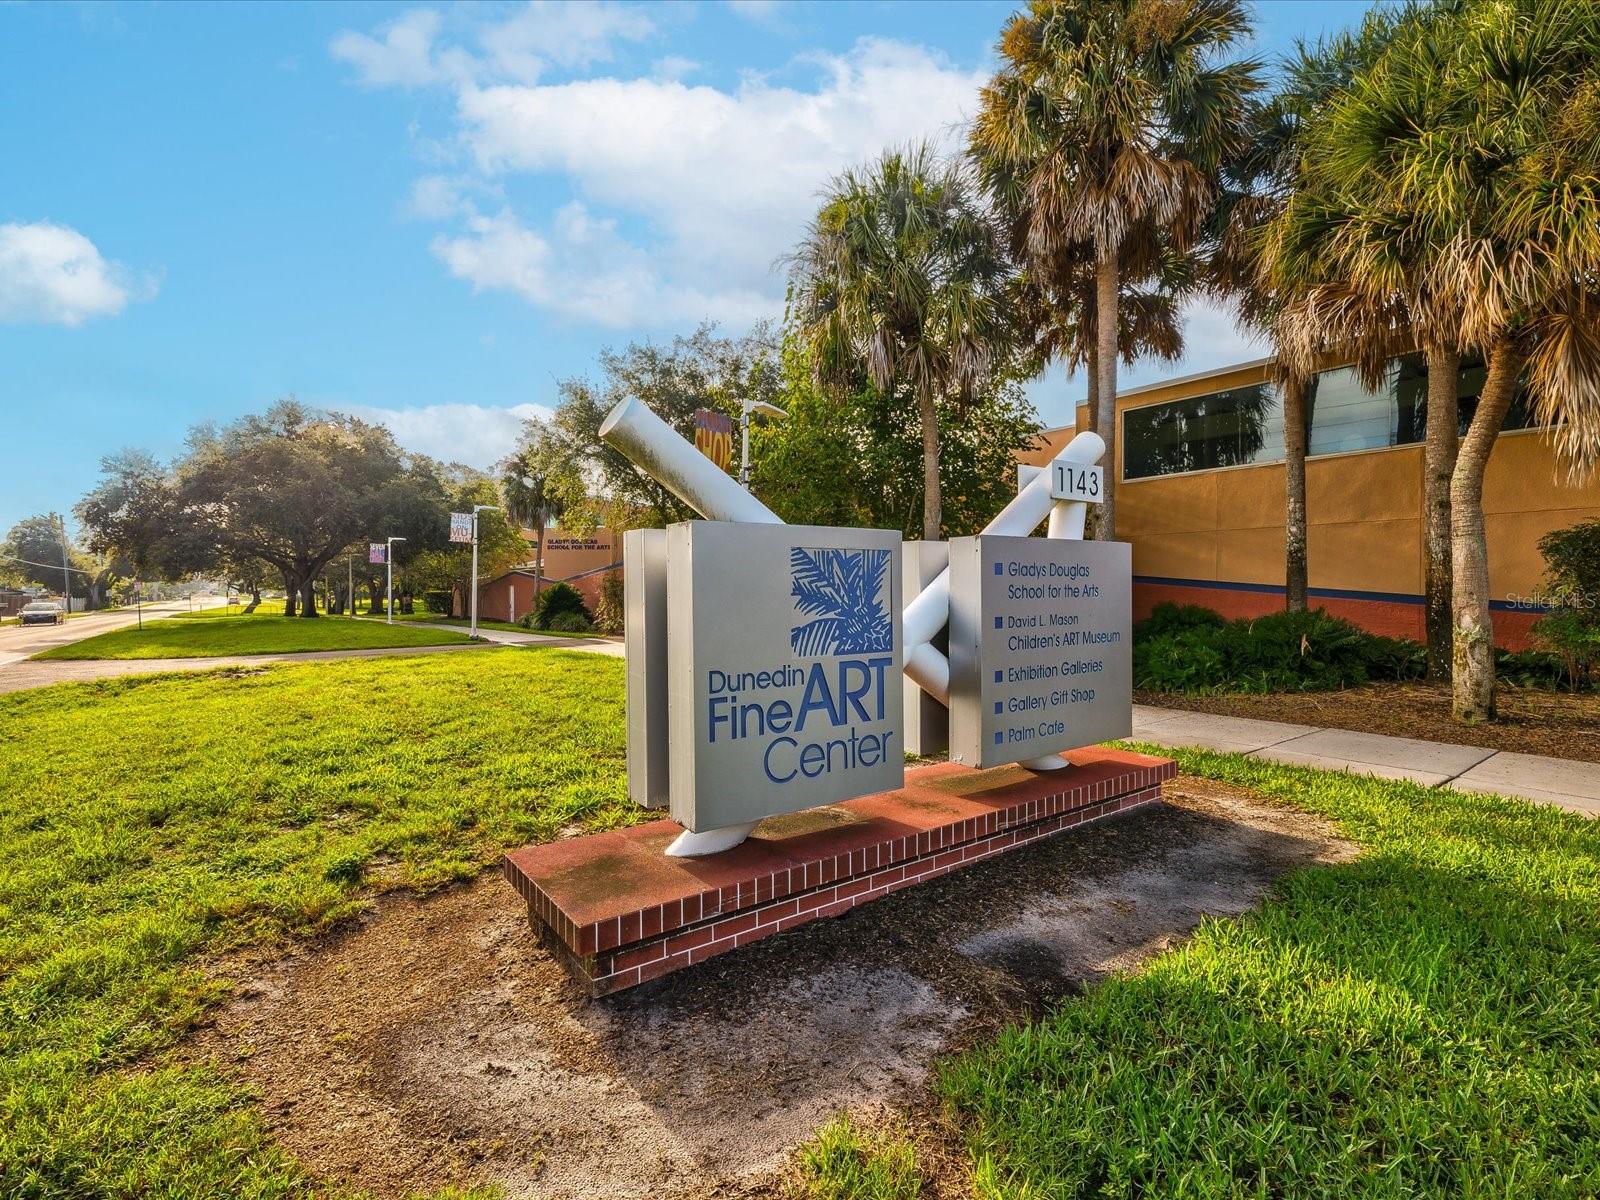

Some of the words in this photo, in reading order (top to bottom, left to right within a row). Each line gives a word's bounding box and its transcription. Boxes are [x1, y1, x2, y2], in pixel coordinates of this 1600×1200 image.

[1058, 467, 1098, 496] 1143
[1008, 562, 1047, 579] Gladys
[1049, 563, 1090, 580] Douglas
[1008, 584, 1045, 599] School
[1048, 585, 1061, 598] for
[1064, 584, 1080, 598] the
[1082, 585, 1099, 597] Arts
[1008, 615, 1036, 629] David
[1039, 615, 1047, 627] L.
[1049, 614, 1079, 626] Mason
[1008, 634, 1060, 651] Children's
[1063, 632, 1080, 647] ART
[1082, 630, 1120, 645] Museum
[708, 664, 805, 694] Dunedin
[1008, 664, 1058, 682] Exhibition
[1061, 660, 1103, 676] Galleries
[708, 696, 794, 743] Fine
[793, 657, 893, 732] ART
[1008, 696, 1048, 713] Gallery
[1050, 691, 1069, 706] Gift
[1071, 688, 1095, 703] Shop
[1008, 727, 1035, 743] Palm
[1038, 720, 1064, 737] Cafe
[763, 726, 894, 784] Center
